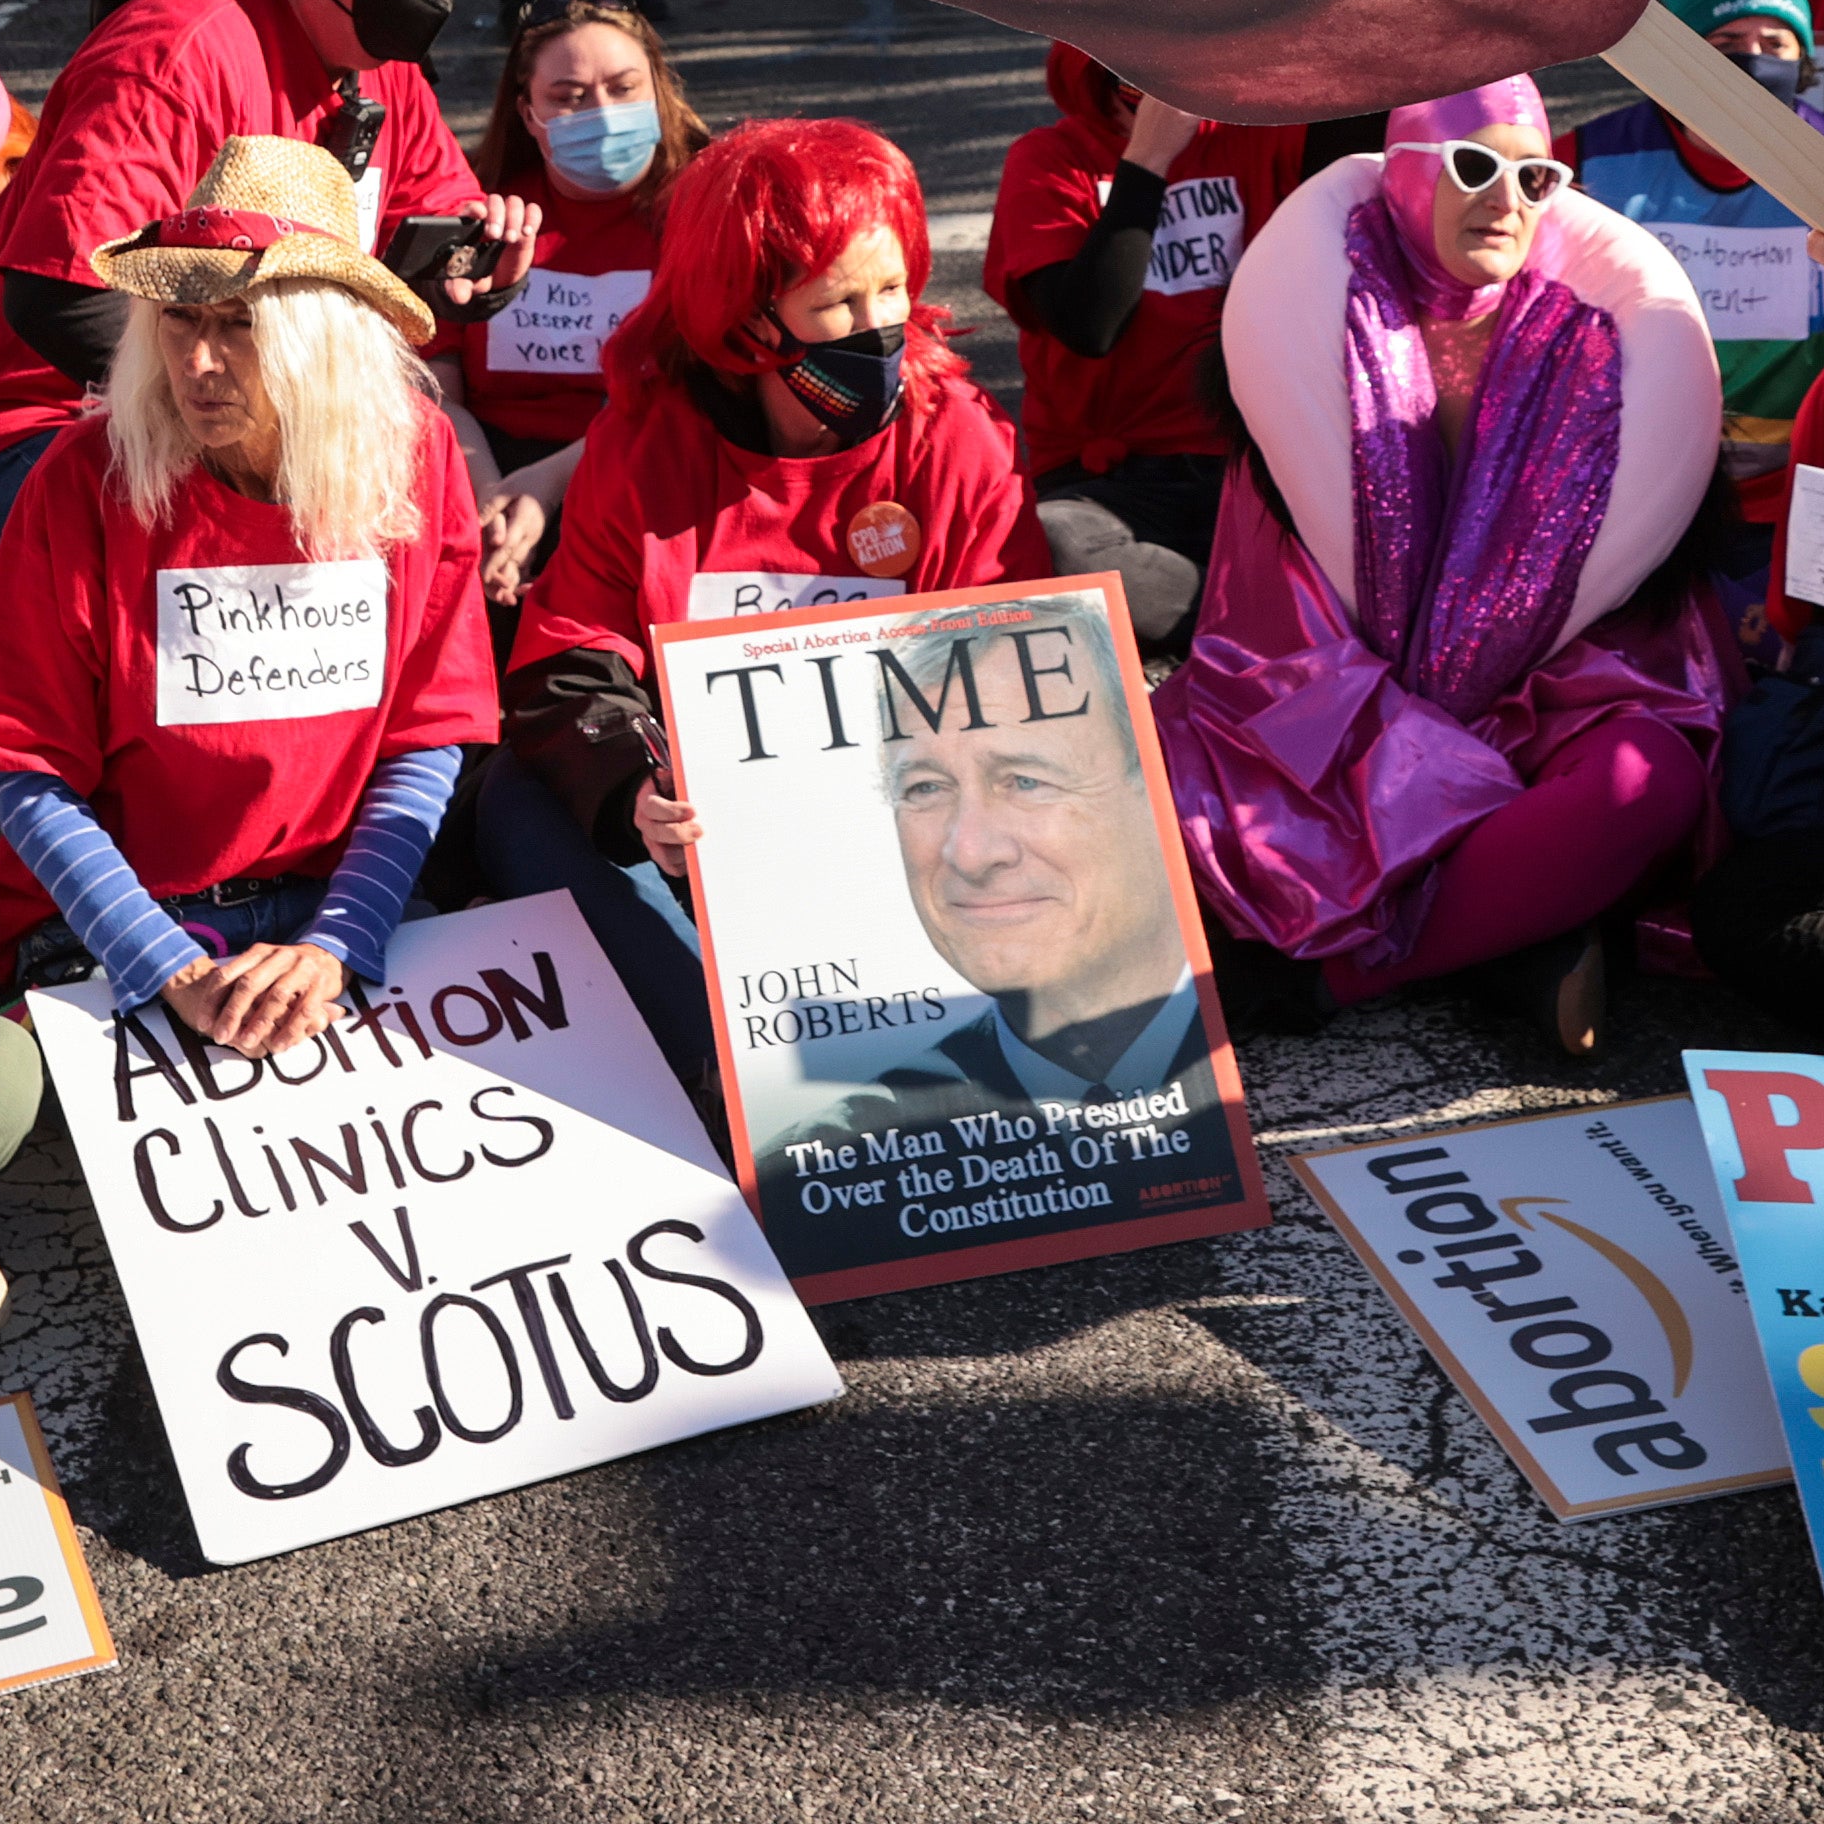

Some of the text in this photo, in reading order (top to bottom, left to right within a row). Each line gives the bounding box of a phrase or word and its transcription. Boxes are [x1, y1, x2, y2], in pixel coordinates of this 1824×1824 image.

[1151, 233, 1229, 282] NDER
[512, 309, 593, 330] DESERVE
[547, 283, 593, 307] KIDS
[1701, 290, 1768, 314] rent
[857, 536, 907, 567] ACTION
[173, 583, 371, 635] Pinkhouse
[743, 608, 1033, 659] Special Abortion Access Front Edition
[182, 648, 369, 697] Defenders
[706, 625, 1092, 763] TIME
[737, 958, 861, 1008] JOHN
[745, 986, 946, 1050] ROBERTS
[785, 1082, 1190, 1178] The Man Who Presided
[801, 1123, 1191, 1216] Over the Death Of The
[1599, 1140, 1654, 1182] want
[899, 1178, 1113, 1238] Constitution
[1644, 1183, 1694, 1216] you
[1679, 1219, 1738, 1274] When
[1367, 1147, 1707, 1475] abortion
[217, 1219, 763, 1500] SCOTUS
